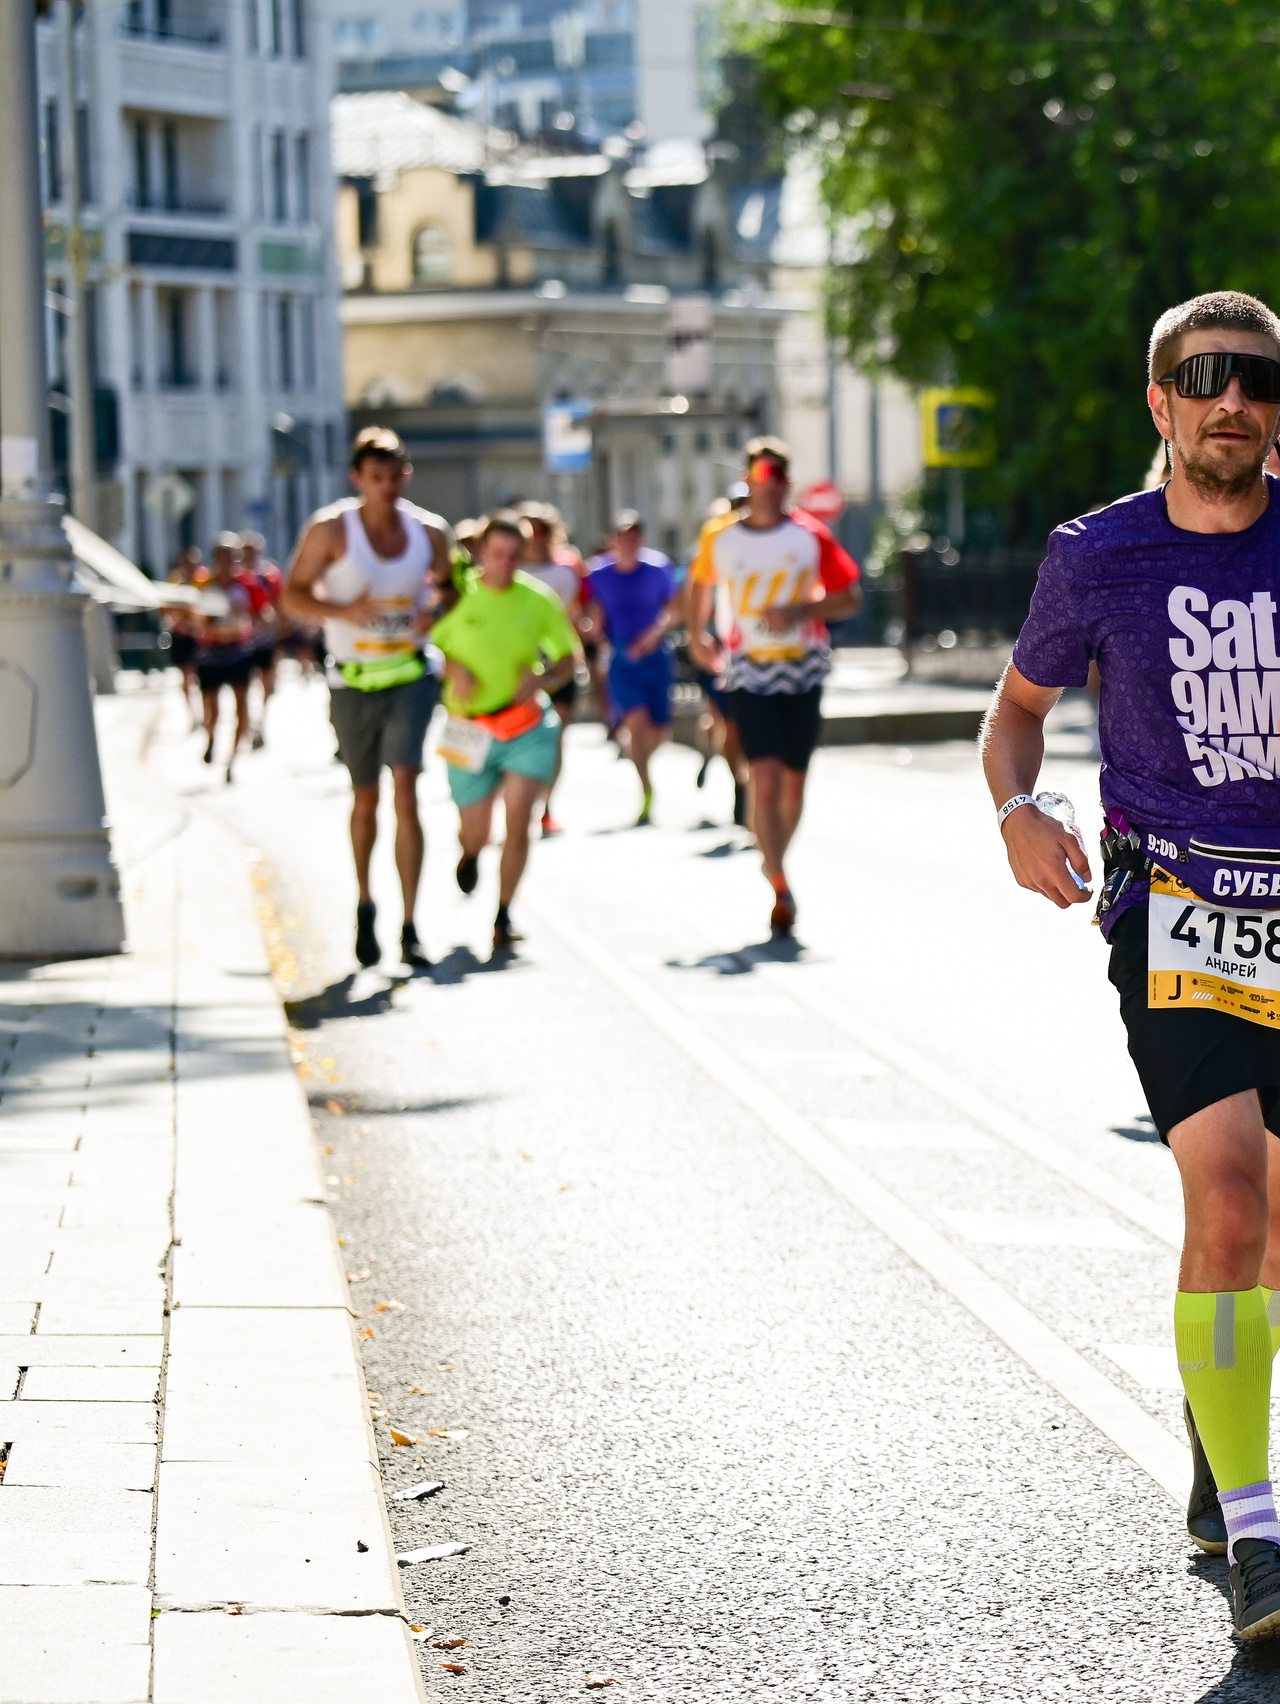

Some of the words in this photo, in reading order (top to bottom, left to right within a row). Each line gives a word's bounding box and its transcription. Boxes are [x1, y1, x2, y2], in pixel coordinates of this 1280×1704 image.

[1003, 796, 1026, 815] 4158
[1147, 833, 1178, 861] 9:00
[1205, 955, 1258, 979] АНДРЕЙ
[1167, 974, 1182, 1001] J
